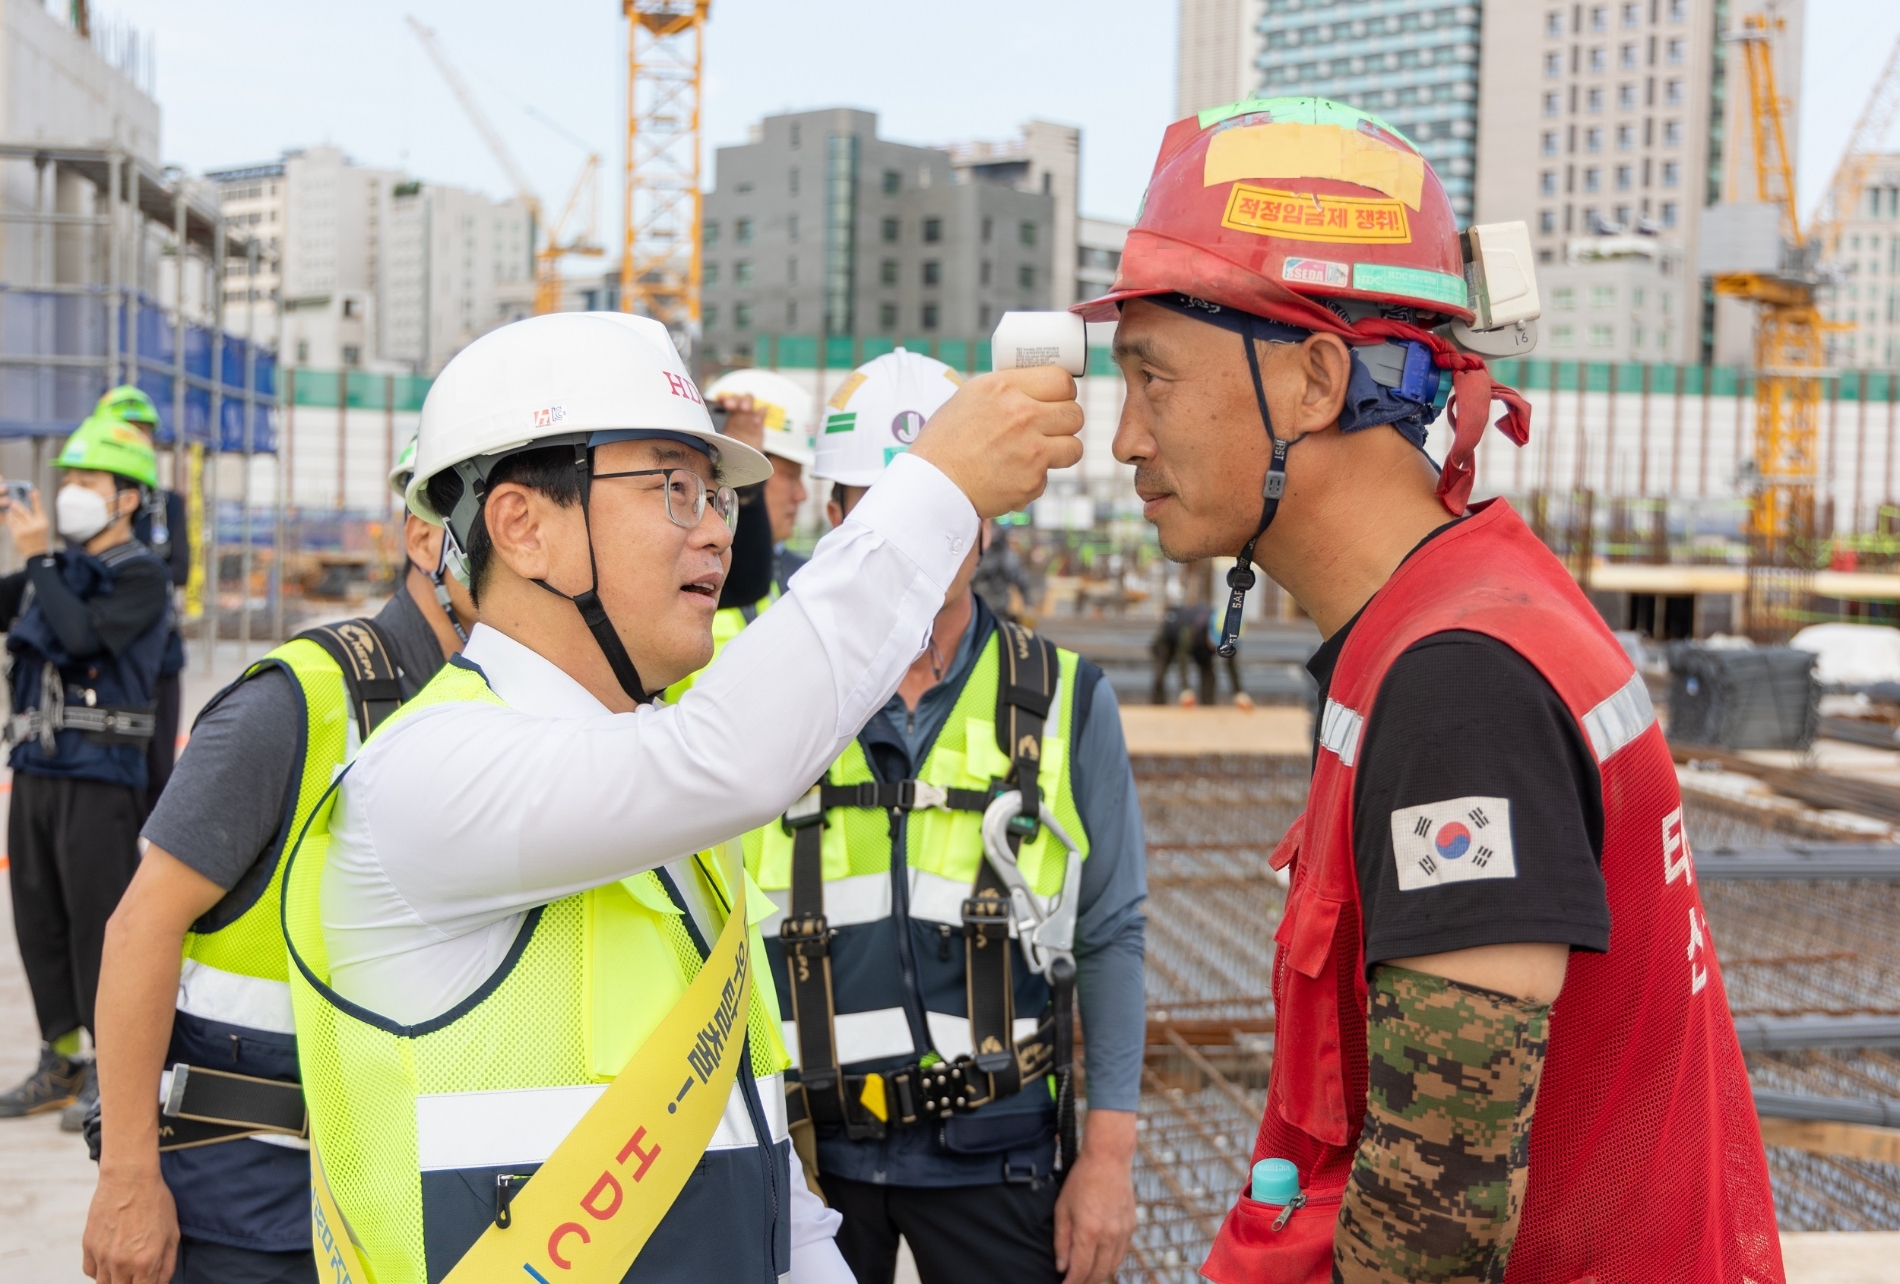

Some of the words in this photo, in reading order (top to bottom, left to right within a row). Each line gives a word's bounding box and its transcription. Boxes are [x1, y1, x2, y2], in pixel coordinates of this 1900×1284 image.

[1238, 197, 1348, 229] 적정임금제
[1355, 209, 1400, 231] 쟁취!
[1515, 332, 1528, 346] 16
[1232, 589, 1244, 609] SAF
[1259, 1163, 1291, 1172] VICTORIA
